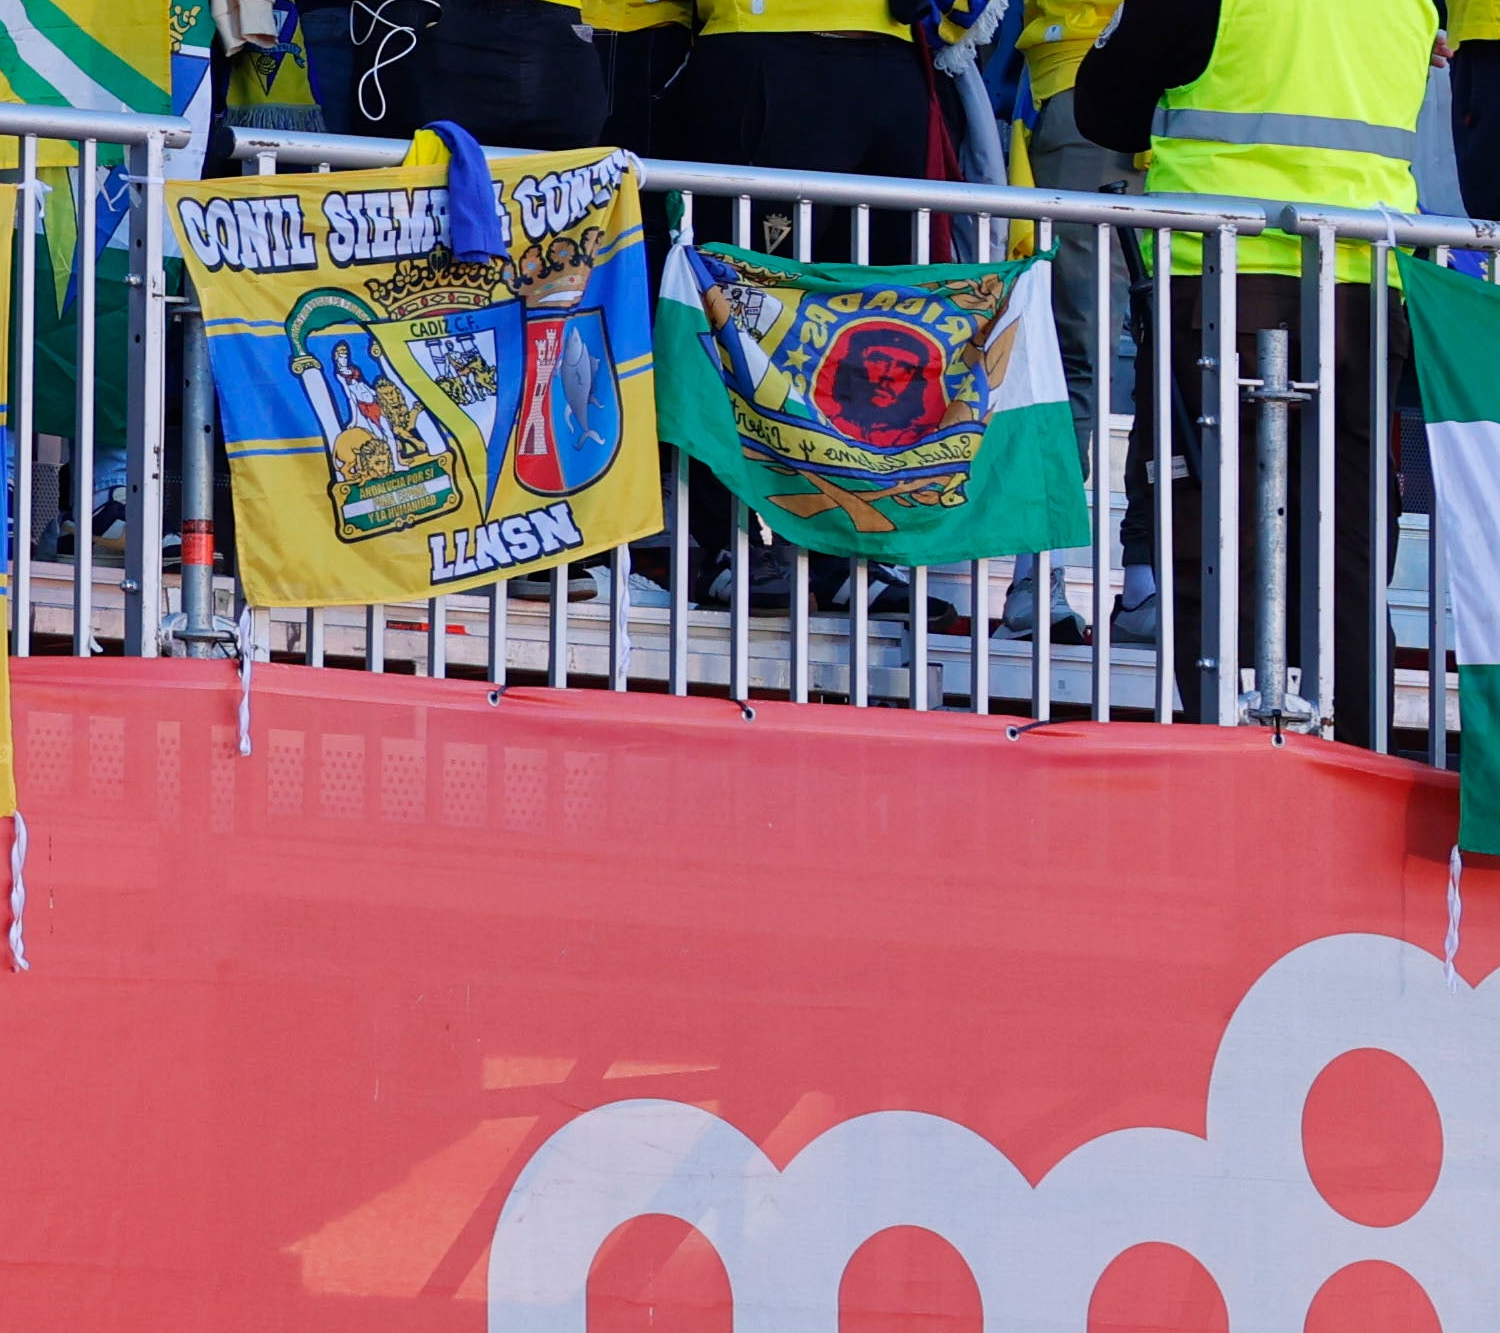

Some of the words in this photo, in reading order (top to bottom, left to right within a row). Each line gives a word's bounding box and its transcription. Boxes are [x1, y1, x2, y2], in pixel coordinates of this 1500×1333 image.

[176, 195, 318, 273] CONIL
[410, 318, 452, 338] CADIZ
[454, 316, 480, 332] C.F.
[427, 500, 583, 585] LLNSN
